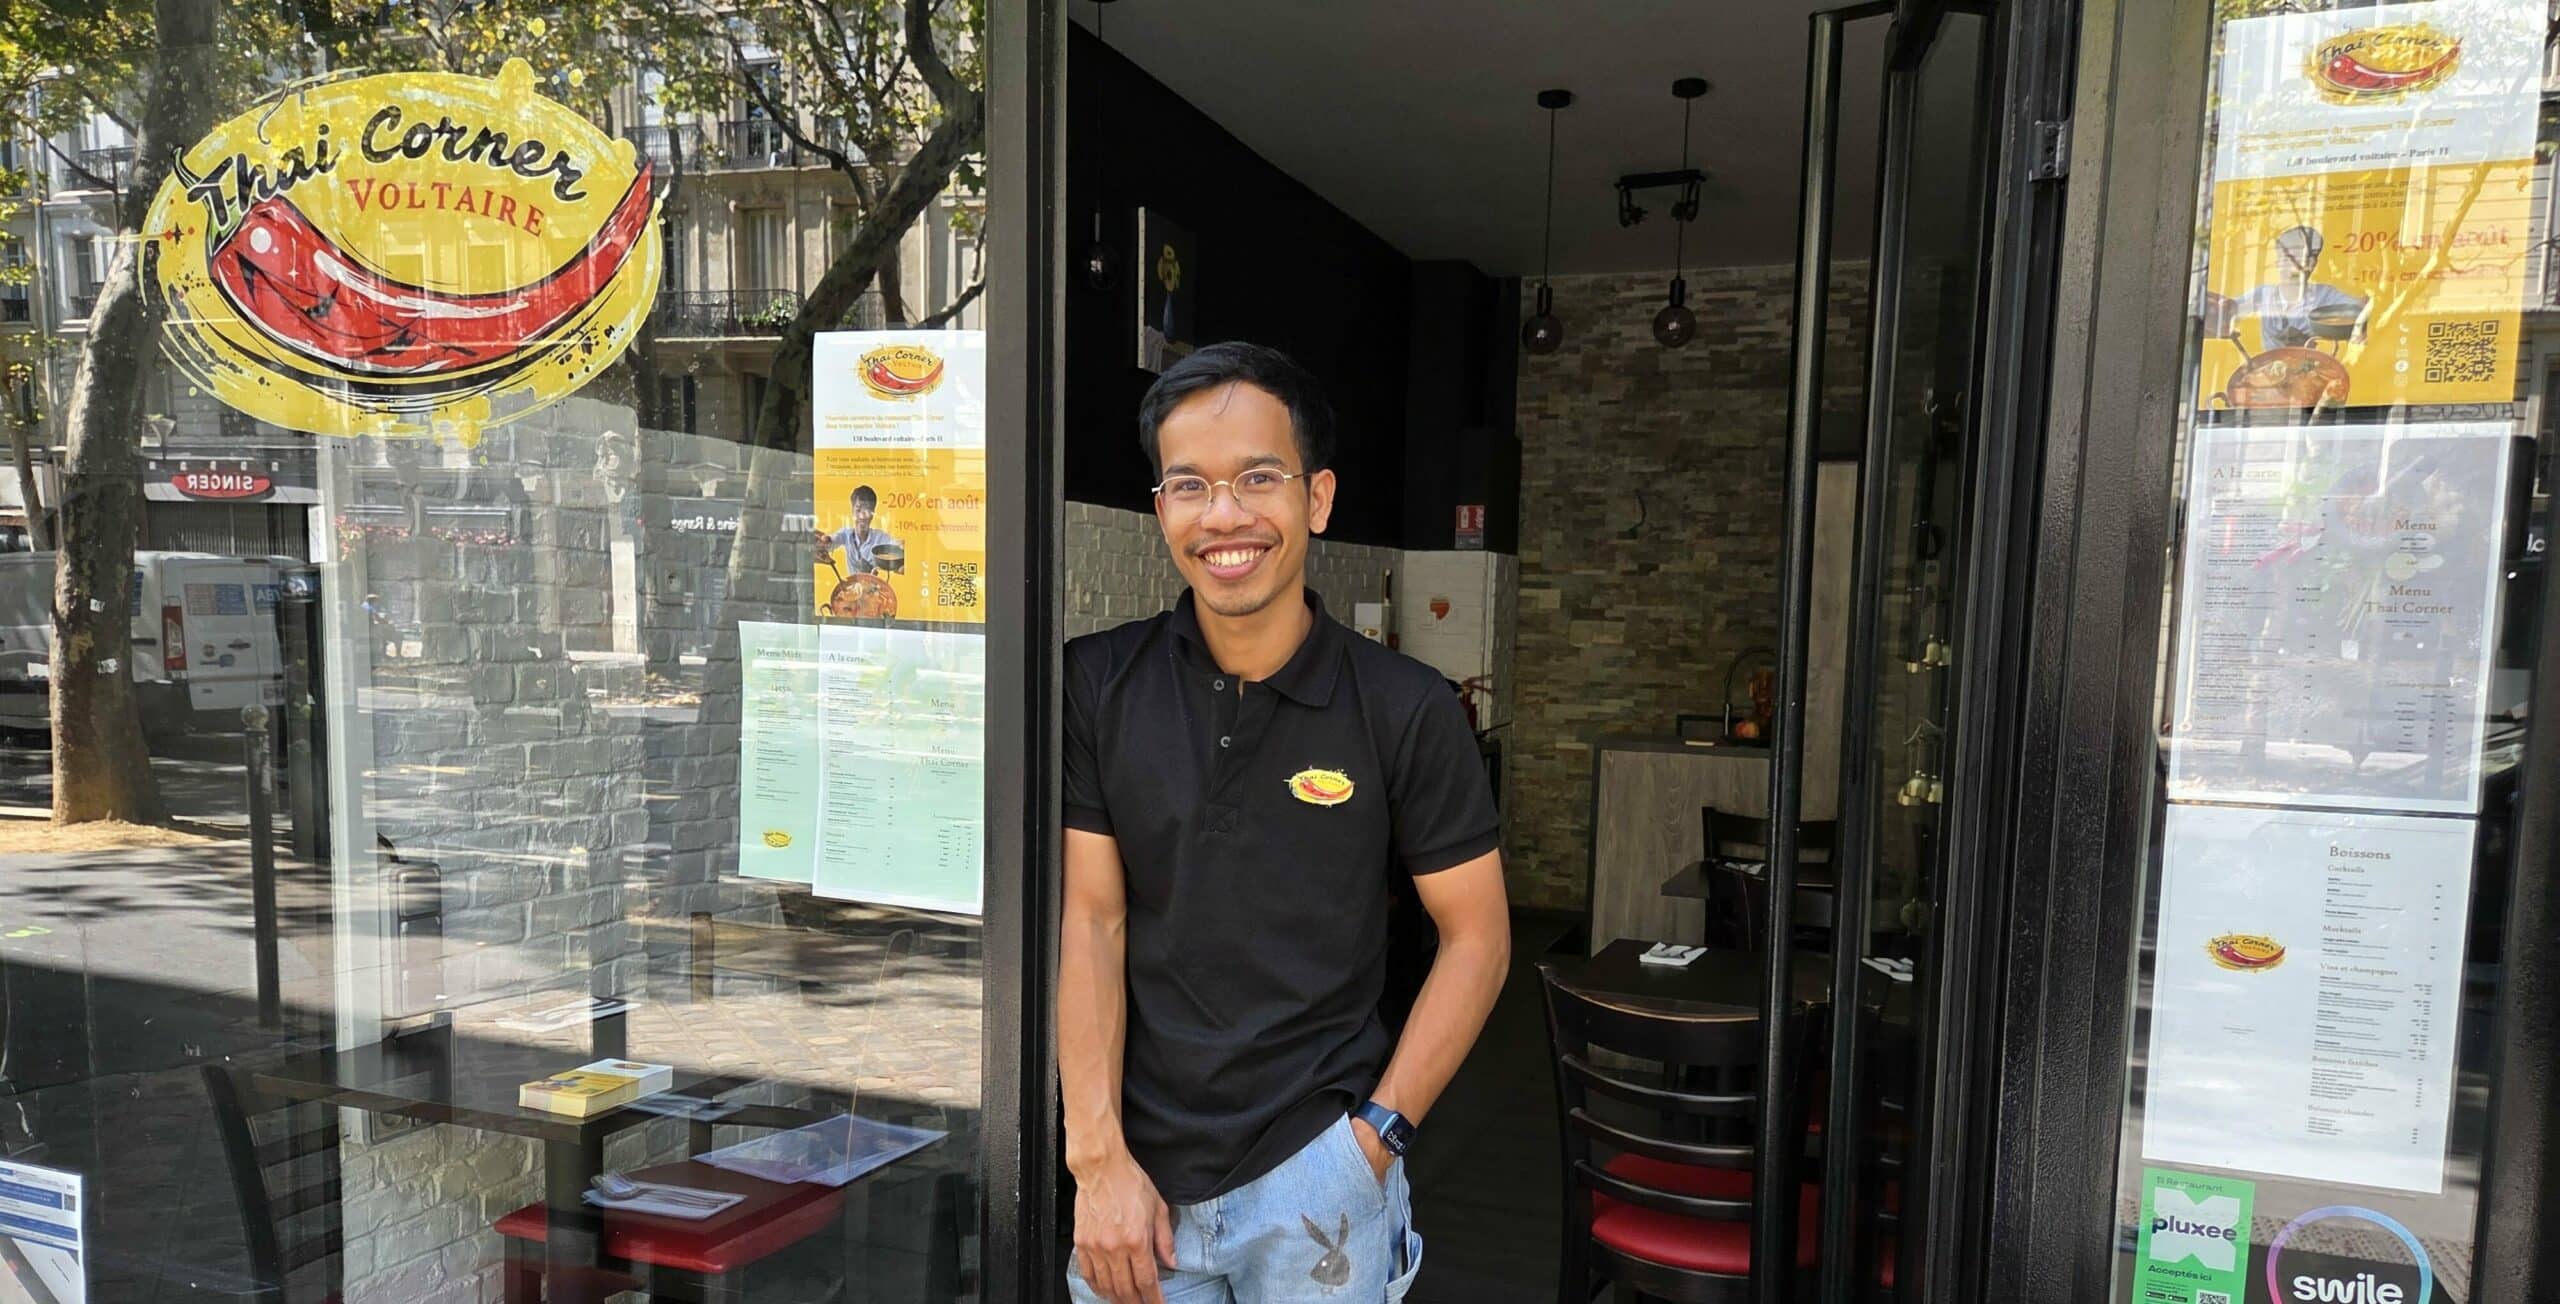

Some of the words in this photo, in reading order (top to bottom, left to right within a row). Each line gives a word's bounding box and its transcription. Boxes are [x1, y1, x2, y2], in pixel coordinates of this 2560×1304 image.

[2319, 35, 2365, 58] Thai
[187, 123, 341, 226] Thai
[360, 104, 588, 201] Corner
[346, 176, 545, 237] VOLTAIRE
[2332, 231, 2403, 254] -20%
[864, 355, 890, 368] Thai
[895, 350, 933, 366] Corner
[882, 492, 921, 509] -20%
[926, 498, 944, 509] en
[947, 494, 979, 510] août
[895, 521, 919, 532] -10%
[920, 524, 933, 532] en
[2394, 519, 2437, 531] Menu
[2389, 585, 2432, 597] Menu
[2364, 601, 2398, 614] Thai
[2402, 602, 2455, 615] Corner
[828, 652, 836, 662] A
[2329, 846, 2391, 860] Boissons
[2215, 938, 2239, 947] Thai
[2242, 938, 2274, 951] Corner
[2151, 1215, 2237, 1242] pluxee
[2147, 1264, 2198, 1281] Acceptés
[2199, 1271, 2213, 1282] ici
[2291, 1272, 2404, 1304] swile
